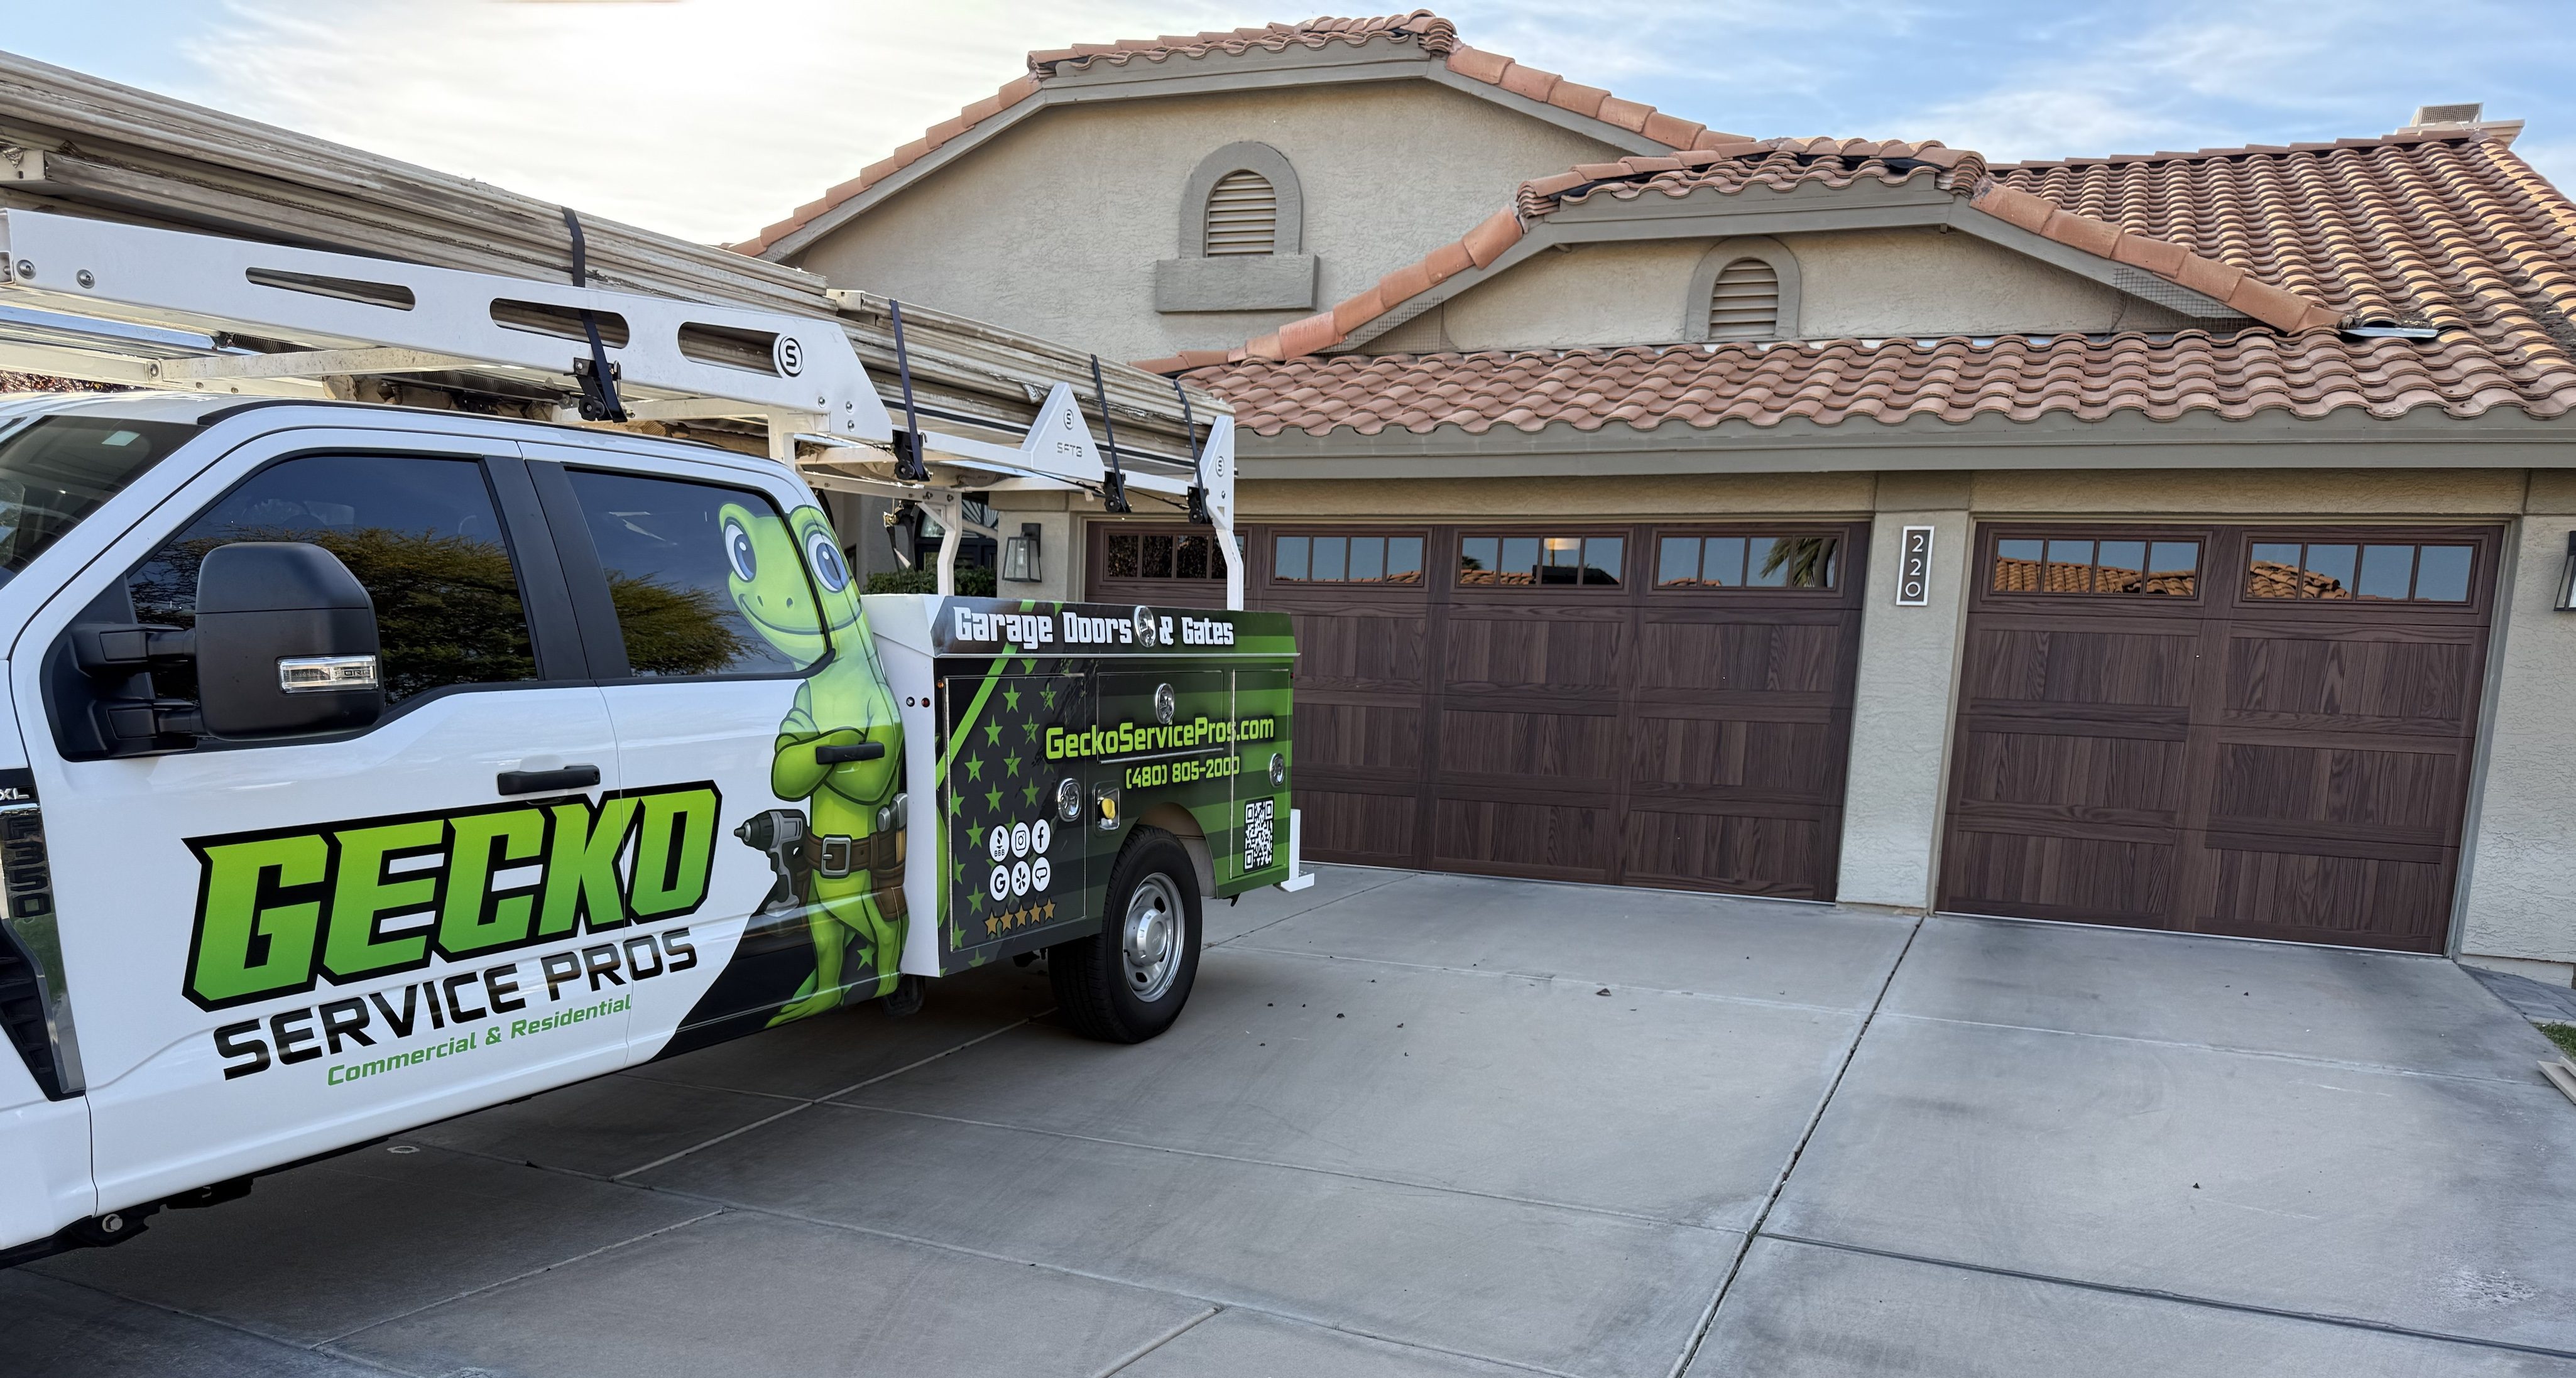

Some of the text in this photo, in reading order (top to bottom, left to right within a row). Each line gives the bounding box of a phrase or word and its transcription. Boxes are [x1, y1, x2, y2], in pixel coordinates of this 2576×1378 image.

[785, 345, 797, 367] S
[1904, 534, 1924, 597] 220
[953, 606, 1235, 649] Garage Doors & Gates
[1045, 716, 1274, 760] GeckoServicePros.com
[1126, 755, 1240, 789] (480) 805-2000
[0, 787, 30, 801] XL
[994, 849, 1005, 857] BBB
[181, 779, 723, 1013] GECKO
[212, 927, 697, 1080] SERVICE PROS
[327, 994, 631, 1087] Commercial & Residential
